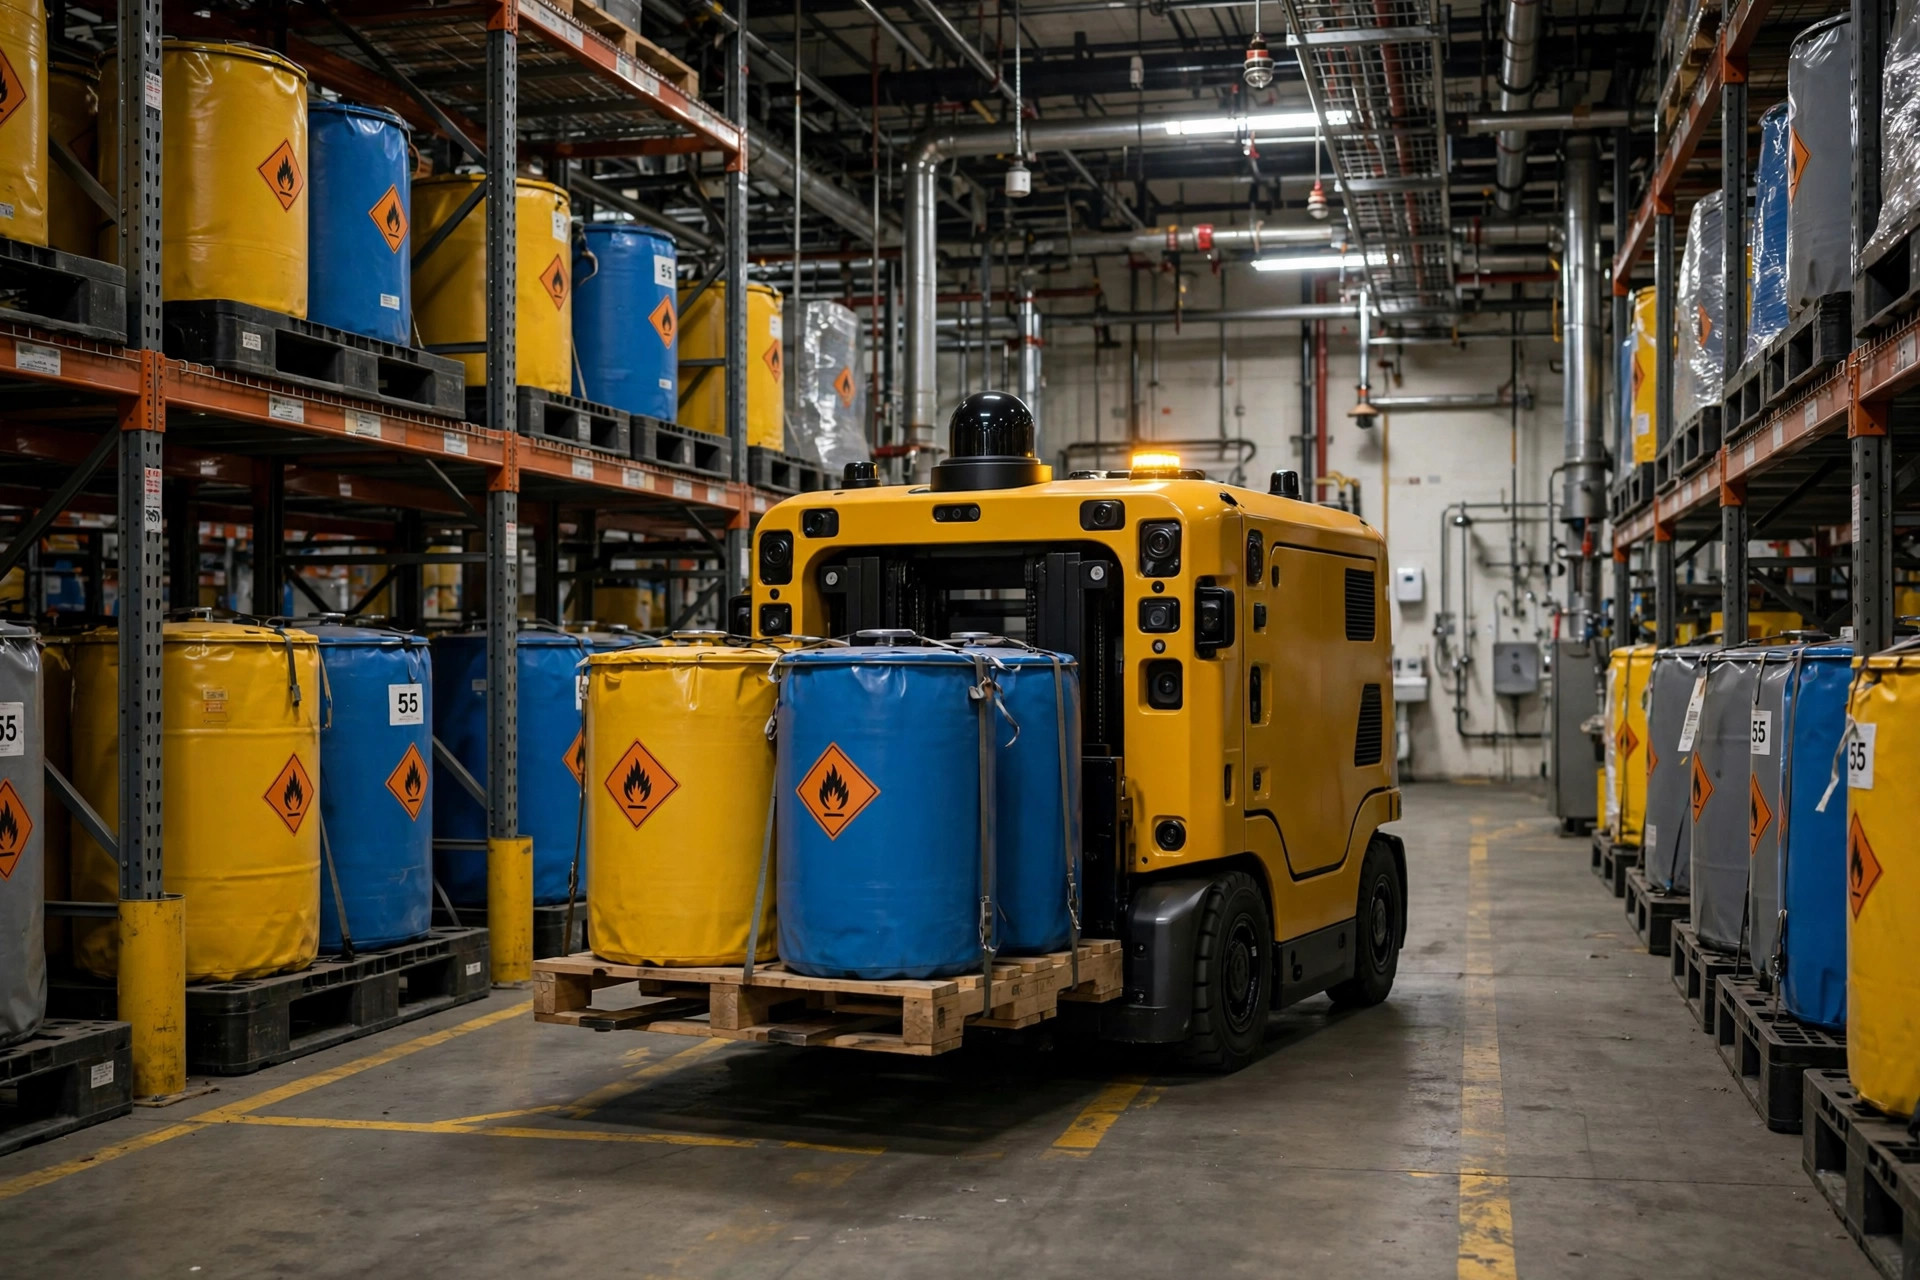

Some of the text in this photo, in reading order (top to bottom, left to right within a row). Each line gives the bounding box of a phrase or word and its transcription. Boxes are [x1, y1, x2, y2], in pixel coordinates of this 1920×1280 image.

[398, 692, 418, 714] 55
[1752, 720, 1766, 743] 55
[1850, 742, 1866, 771] 55
